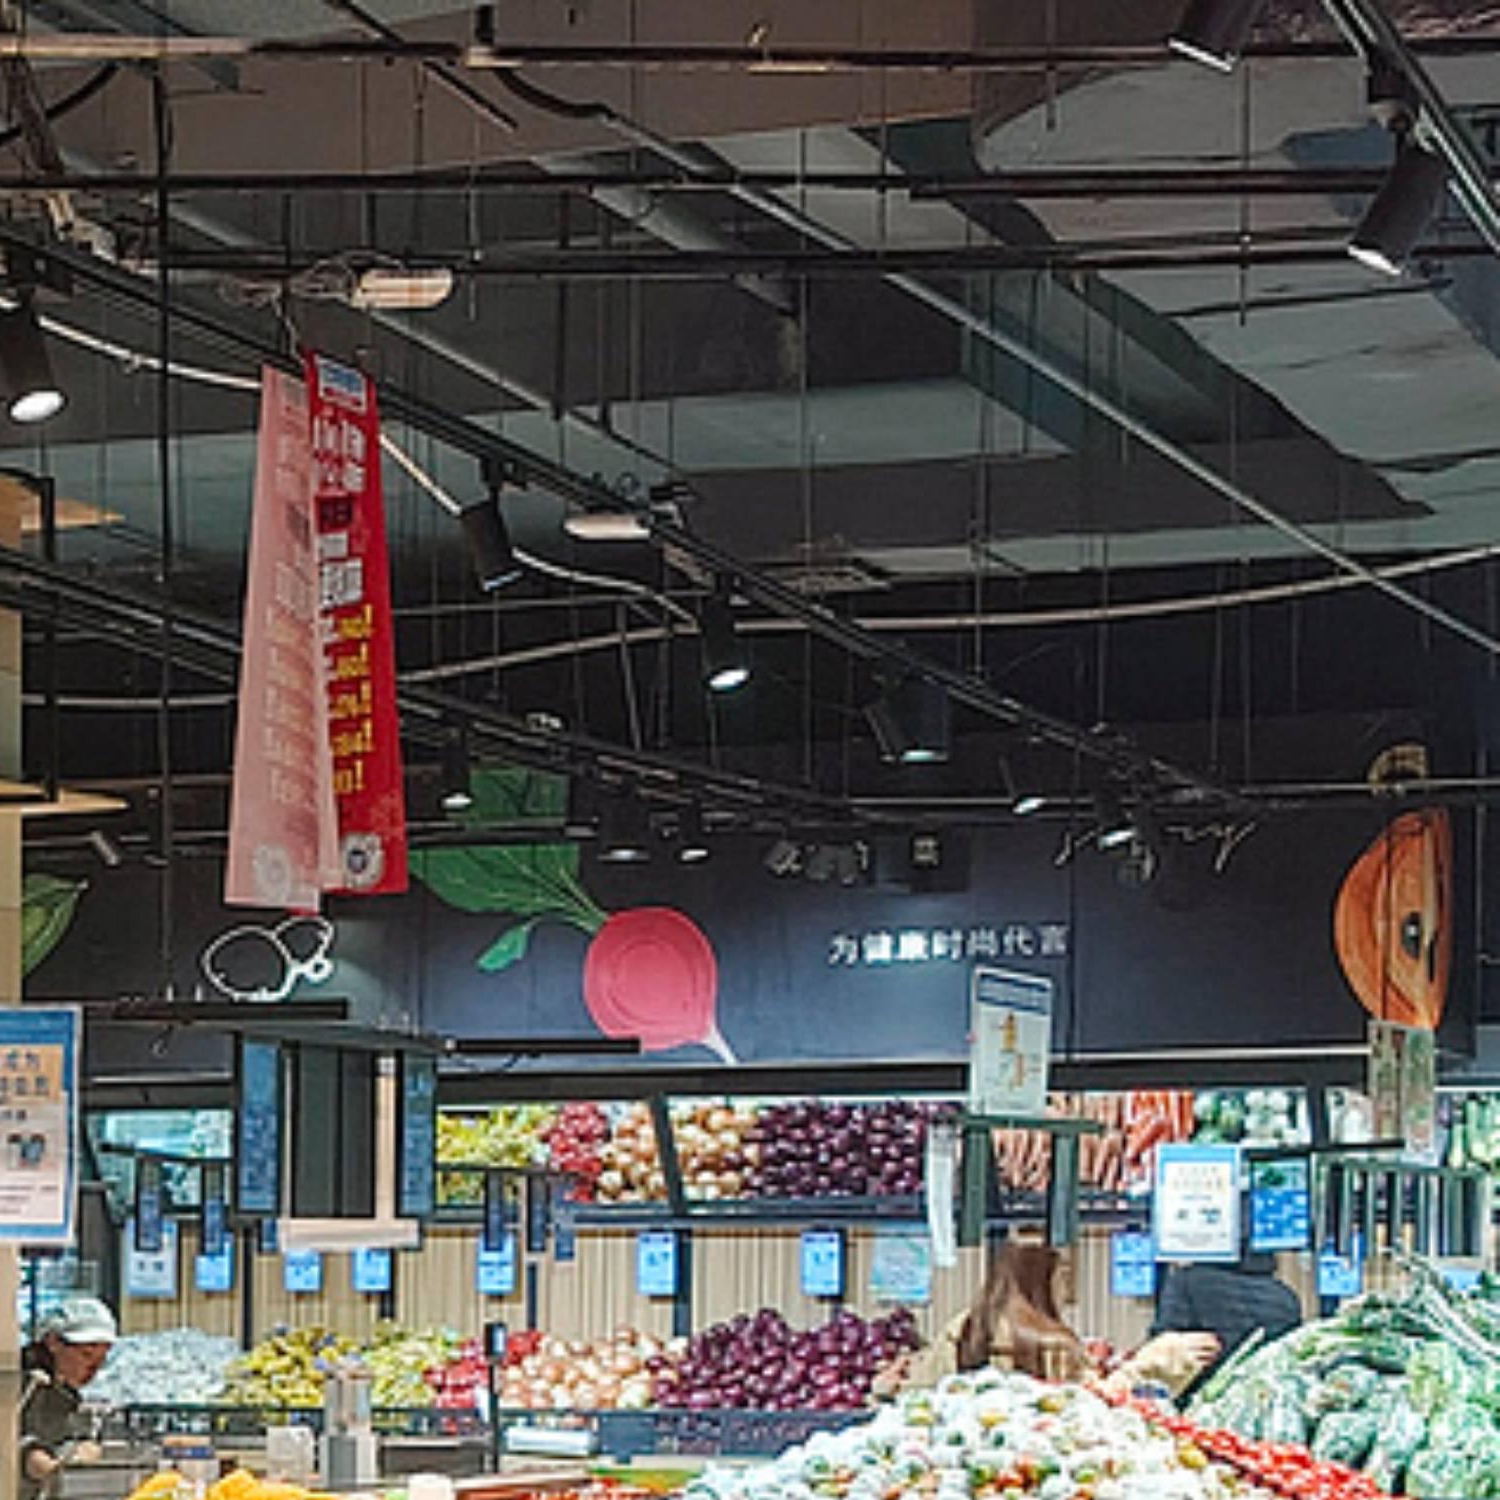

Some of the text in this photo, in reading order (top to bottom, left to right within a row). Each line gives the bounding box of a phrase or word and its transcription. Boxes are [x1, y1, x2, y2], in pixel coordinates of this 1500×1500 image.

[829, 924, 1069, 965] 为健康时尚代言
